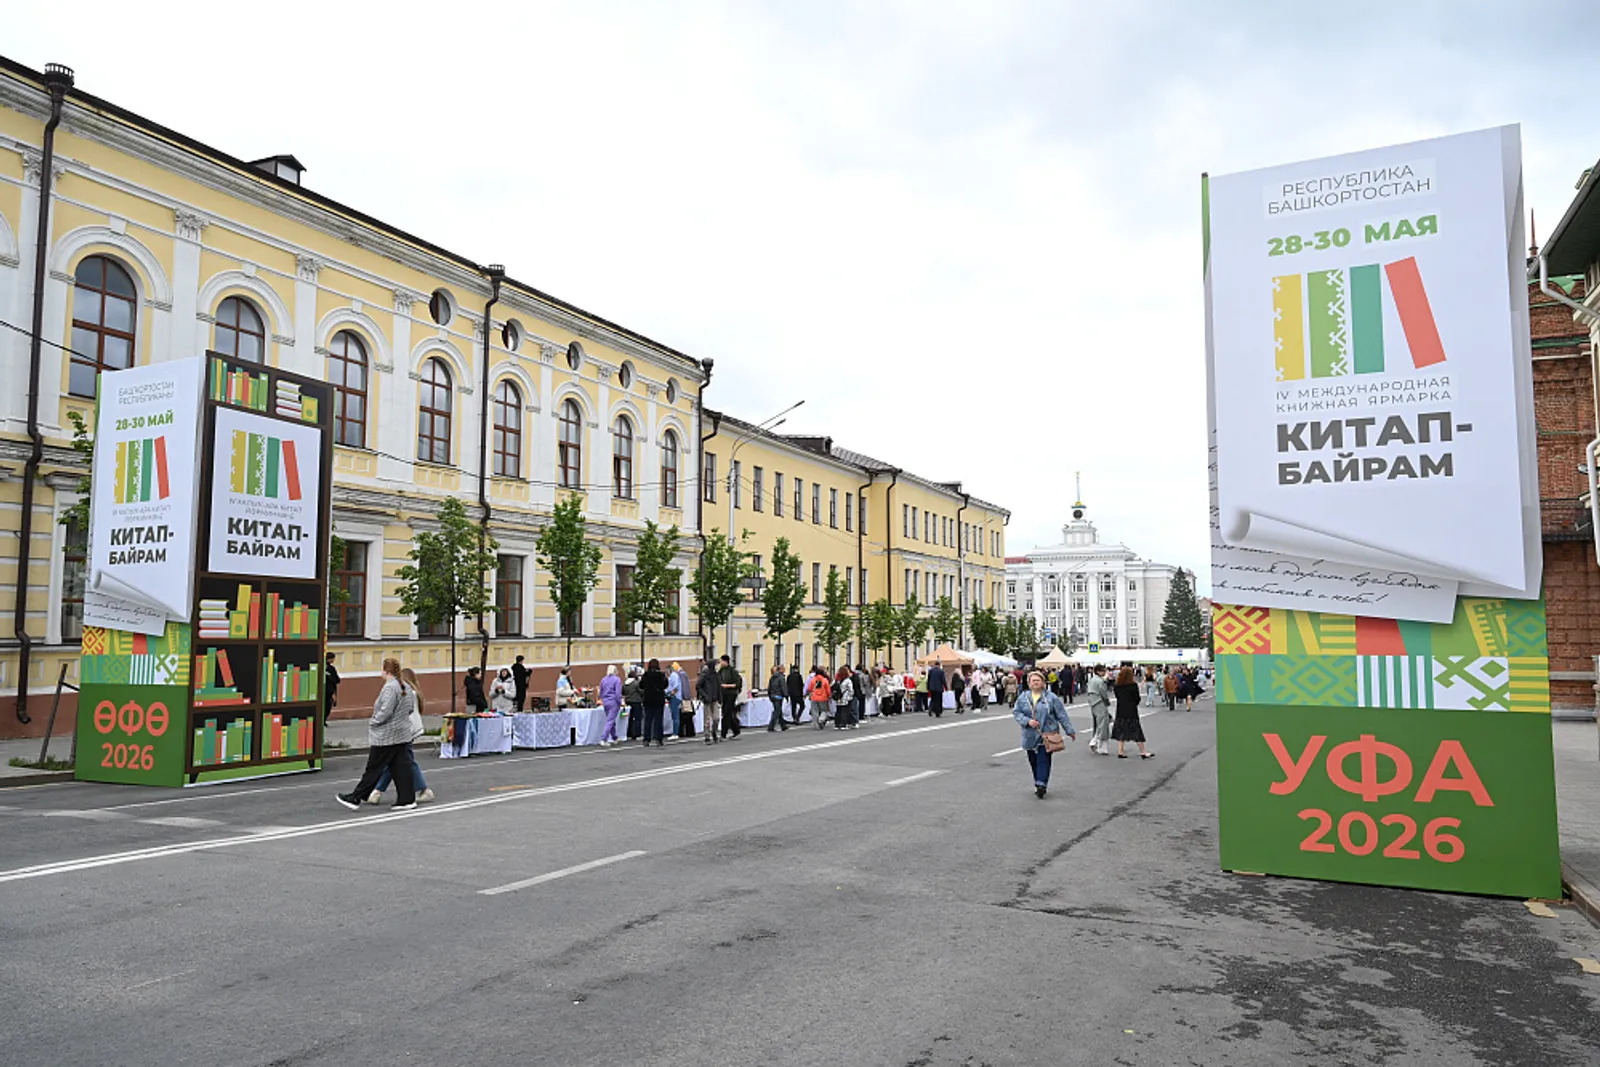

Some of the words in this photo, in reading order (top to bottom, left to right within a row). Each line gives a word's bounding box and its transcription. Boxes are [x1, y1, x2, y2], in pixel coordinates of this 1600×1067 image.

[1282, 164, 1414, 197] РЕСПУБЛИКА
[1268, 178, 1431, 215] БАШКОРТОСТАН
[1267, 227, 1351, 257] 28-30
[1364, 214, 1438, 244] МАЯ
[1276, 391, 1289, 401] IV
[1297, 376, 1451, 400] МЕЖДУНАРОДНАЯ
[1276, 397, 1358, 413] КНИЖНАЯ
[1368, 390, 1452, 406] ЯРМАРКА
[115, 416, 145, 431] 28-30
[147, 408, 174, 427] МАЙ
[1276, 411, 1473, 453] КИТАП-
[1278, 452, 1454, 485] БАЙРАМ
[110, 524, 174, 546] КИТАП-
[227, 516, 309, 542] КИТАП-
[109, 546, 166, 565] БАЙРАМ
[226, 539, 300, 560] БАЙРАМ
[94, 700, 169, 736] ӨФӨ
[101, 742, 154, 770] 2026
[1262, 733, 1496, 807] УФА
[1297, 808, 1465, 863] 2026
